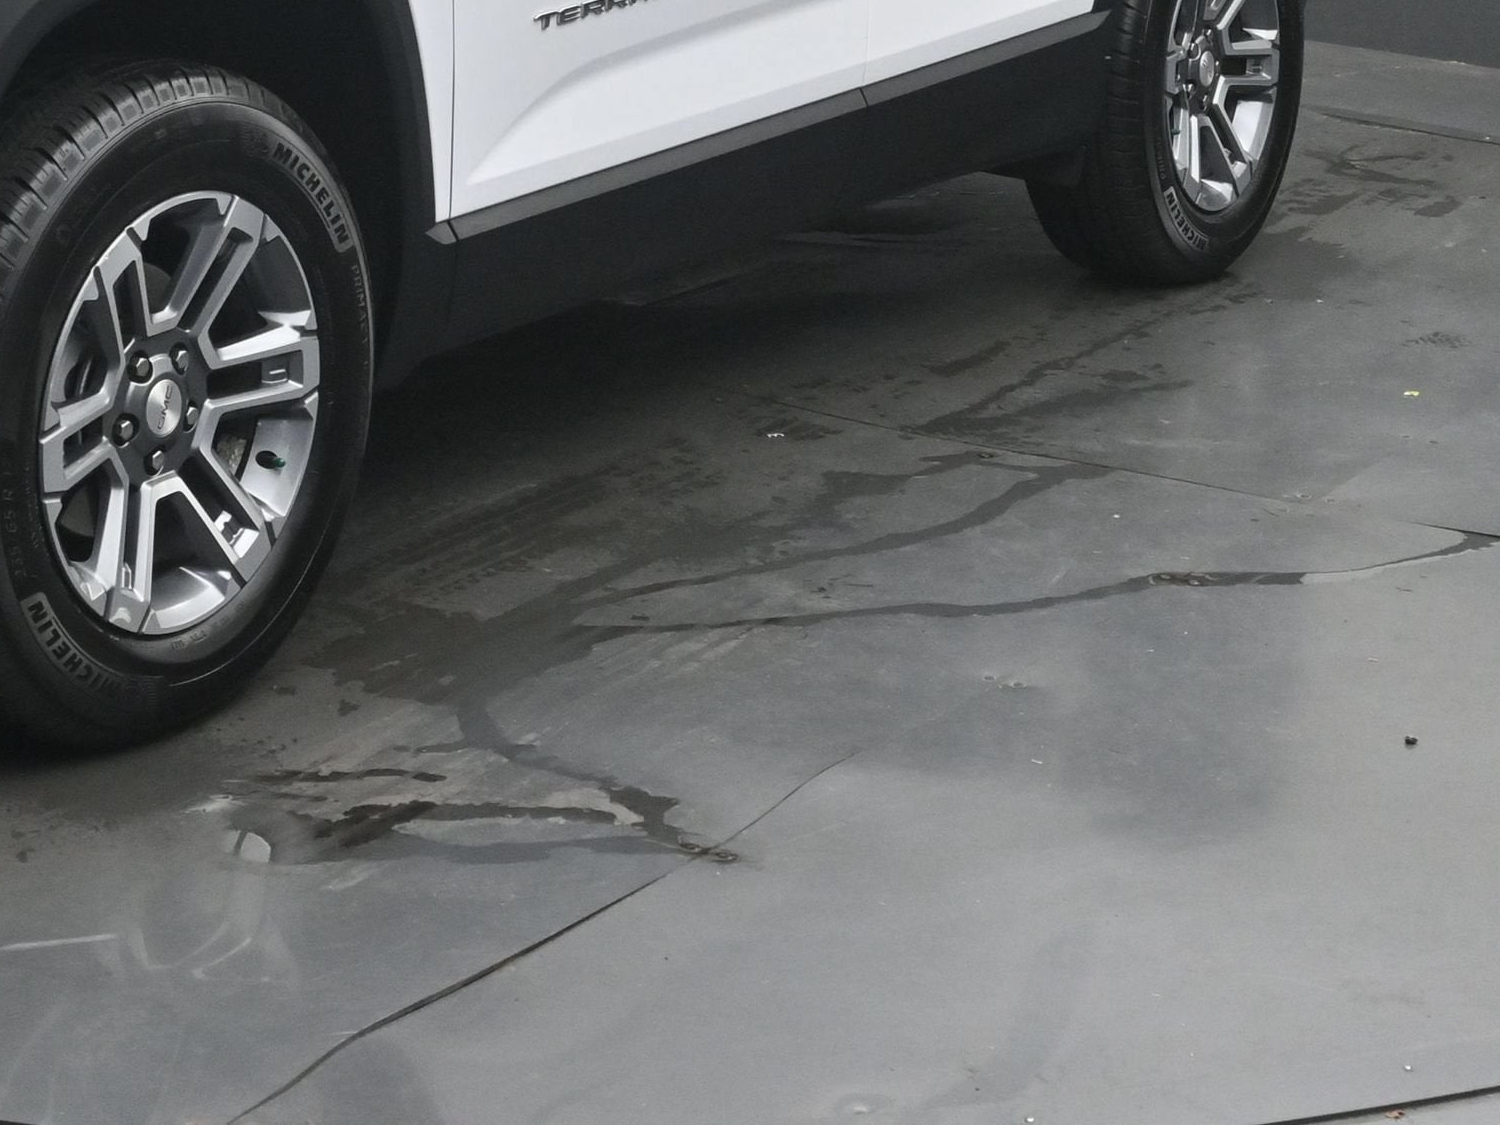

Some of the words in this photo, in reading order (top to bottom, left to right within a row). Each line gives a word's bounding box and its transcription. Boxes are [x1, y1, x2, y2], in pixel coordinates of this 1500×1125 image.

[273, 142, 350, 244] MICHELIN
[1166, 191, 1206, 250] MICHELIN
[157, 385, 173, 429] GMC
[27, 600, 120, 696] MICHELIN
